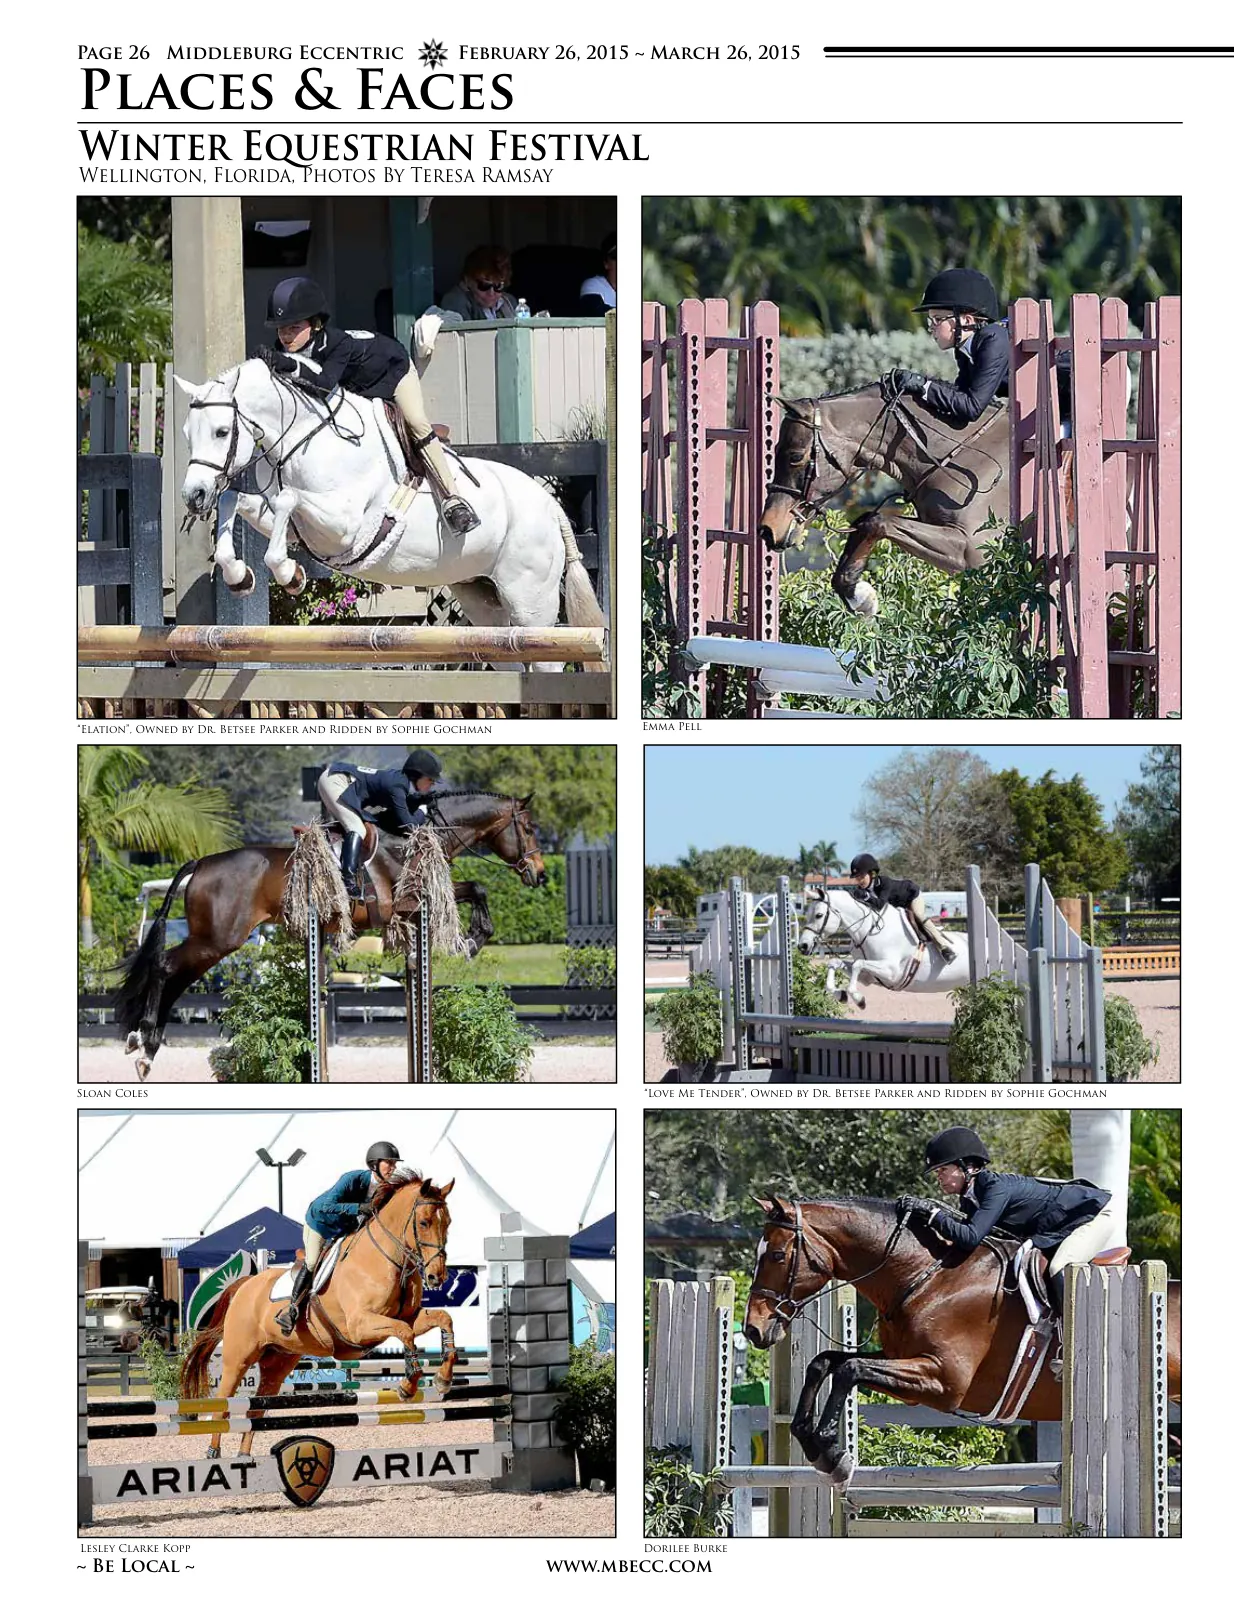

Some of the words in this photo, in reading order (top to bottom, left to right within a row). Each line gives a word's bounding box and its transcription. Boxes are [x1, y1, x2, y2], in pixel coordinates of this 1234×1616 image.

[78, 44, 123, 60] PAGE
[128, 44, 151, 60] 26
[166, 44, 293, 60] MIDDLEBURG
[299, 44, 404, 60] ECCENTRIC
[459, 44, 550, 60] FEBRUARY
[554, 44, 581, 61] 26,
[586, 44, 629, 60] 2015
[650, 44, 720, 60] MARCH
[726, 44, 752, 62] 26,
[758, 44, 800, 60] 2015
[80, 67, 274, 111] PLACES
[294, 66, 342, 111] &
[356, 67, 514, 111] FACES
[77, 129, 234, 162] WINTER
[242, 129, 474, 169] EQUESTRIAN
[488, 129, 650, 162] FESTIVAL
[79, 167, 207, 184] WELLINGTON,
[214, 167, 295, 184] FLORIDA,
[303, 167, 376, 183] PHOTOS
[384, 167, 405, 183] BY
[410, 167, 476, 183] TERESA
[482, 167, 554, 183] RAMSAY
[352, 1449, 481, 1482] ARIAT
[116, 1461, 257, 1498] ARIAT
[93, 1557, 115, 1573] BE
[121, 1557, 181, 1573] LOCAL
